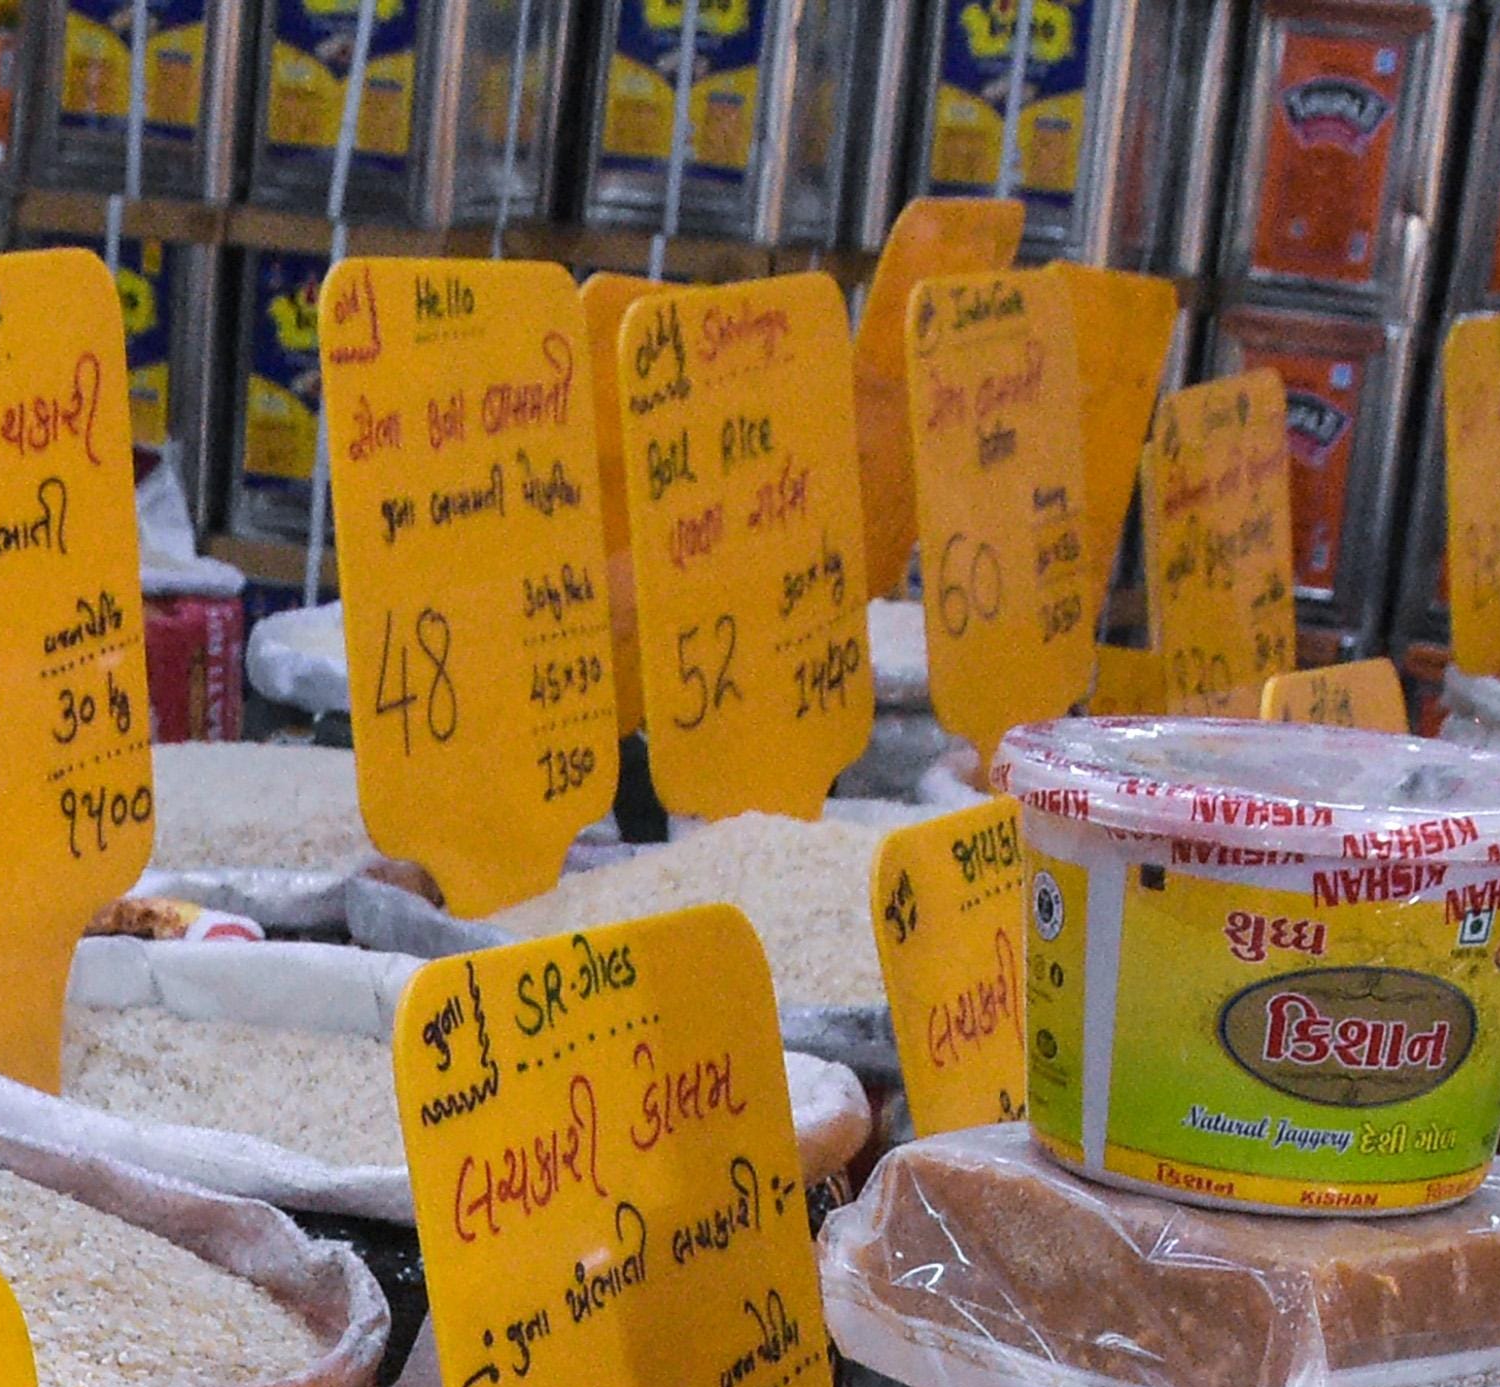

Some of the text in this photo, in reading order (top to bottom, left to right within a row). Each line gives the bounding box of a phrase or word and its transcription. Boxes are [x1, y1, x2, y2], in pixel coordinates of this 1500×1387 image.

[375, 606, 457, 757] 48
[673, 613, 744, 731] 52
[1262, 990, 1450, 1070] કિશાન
[1180, 1104, 1354, 1154] Natural Jaggery
